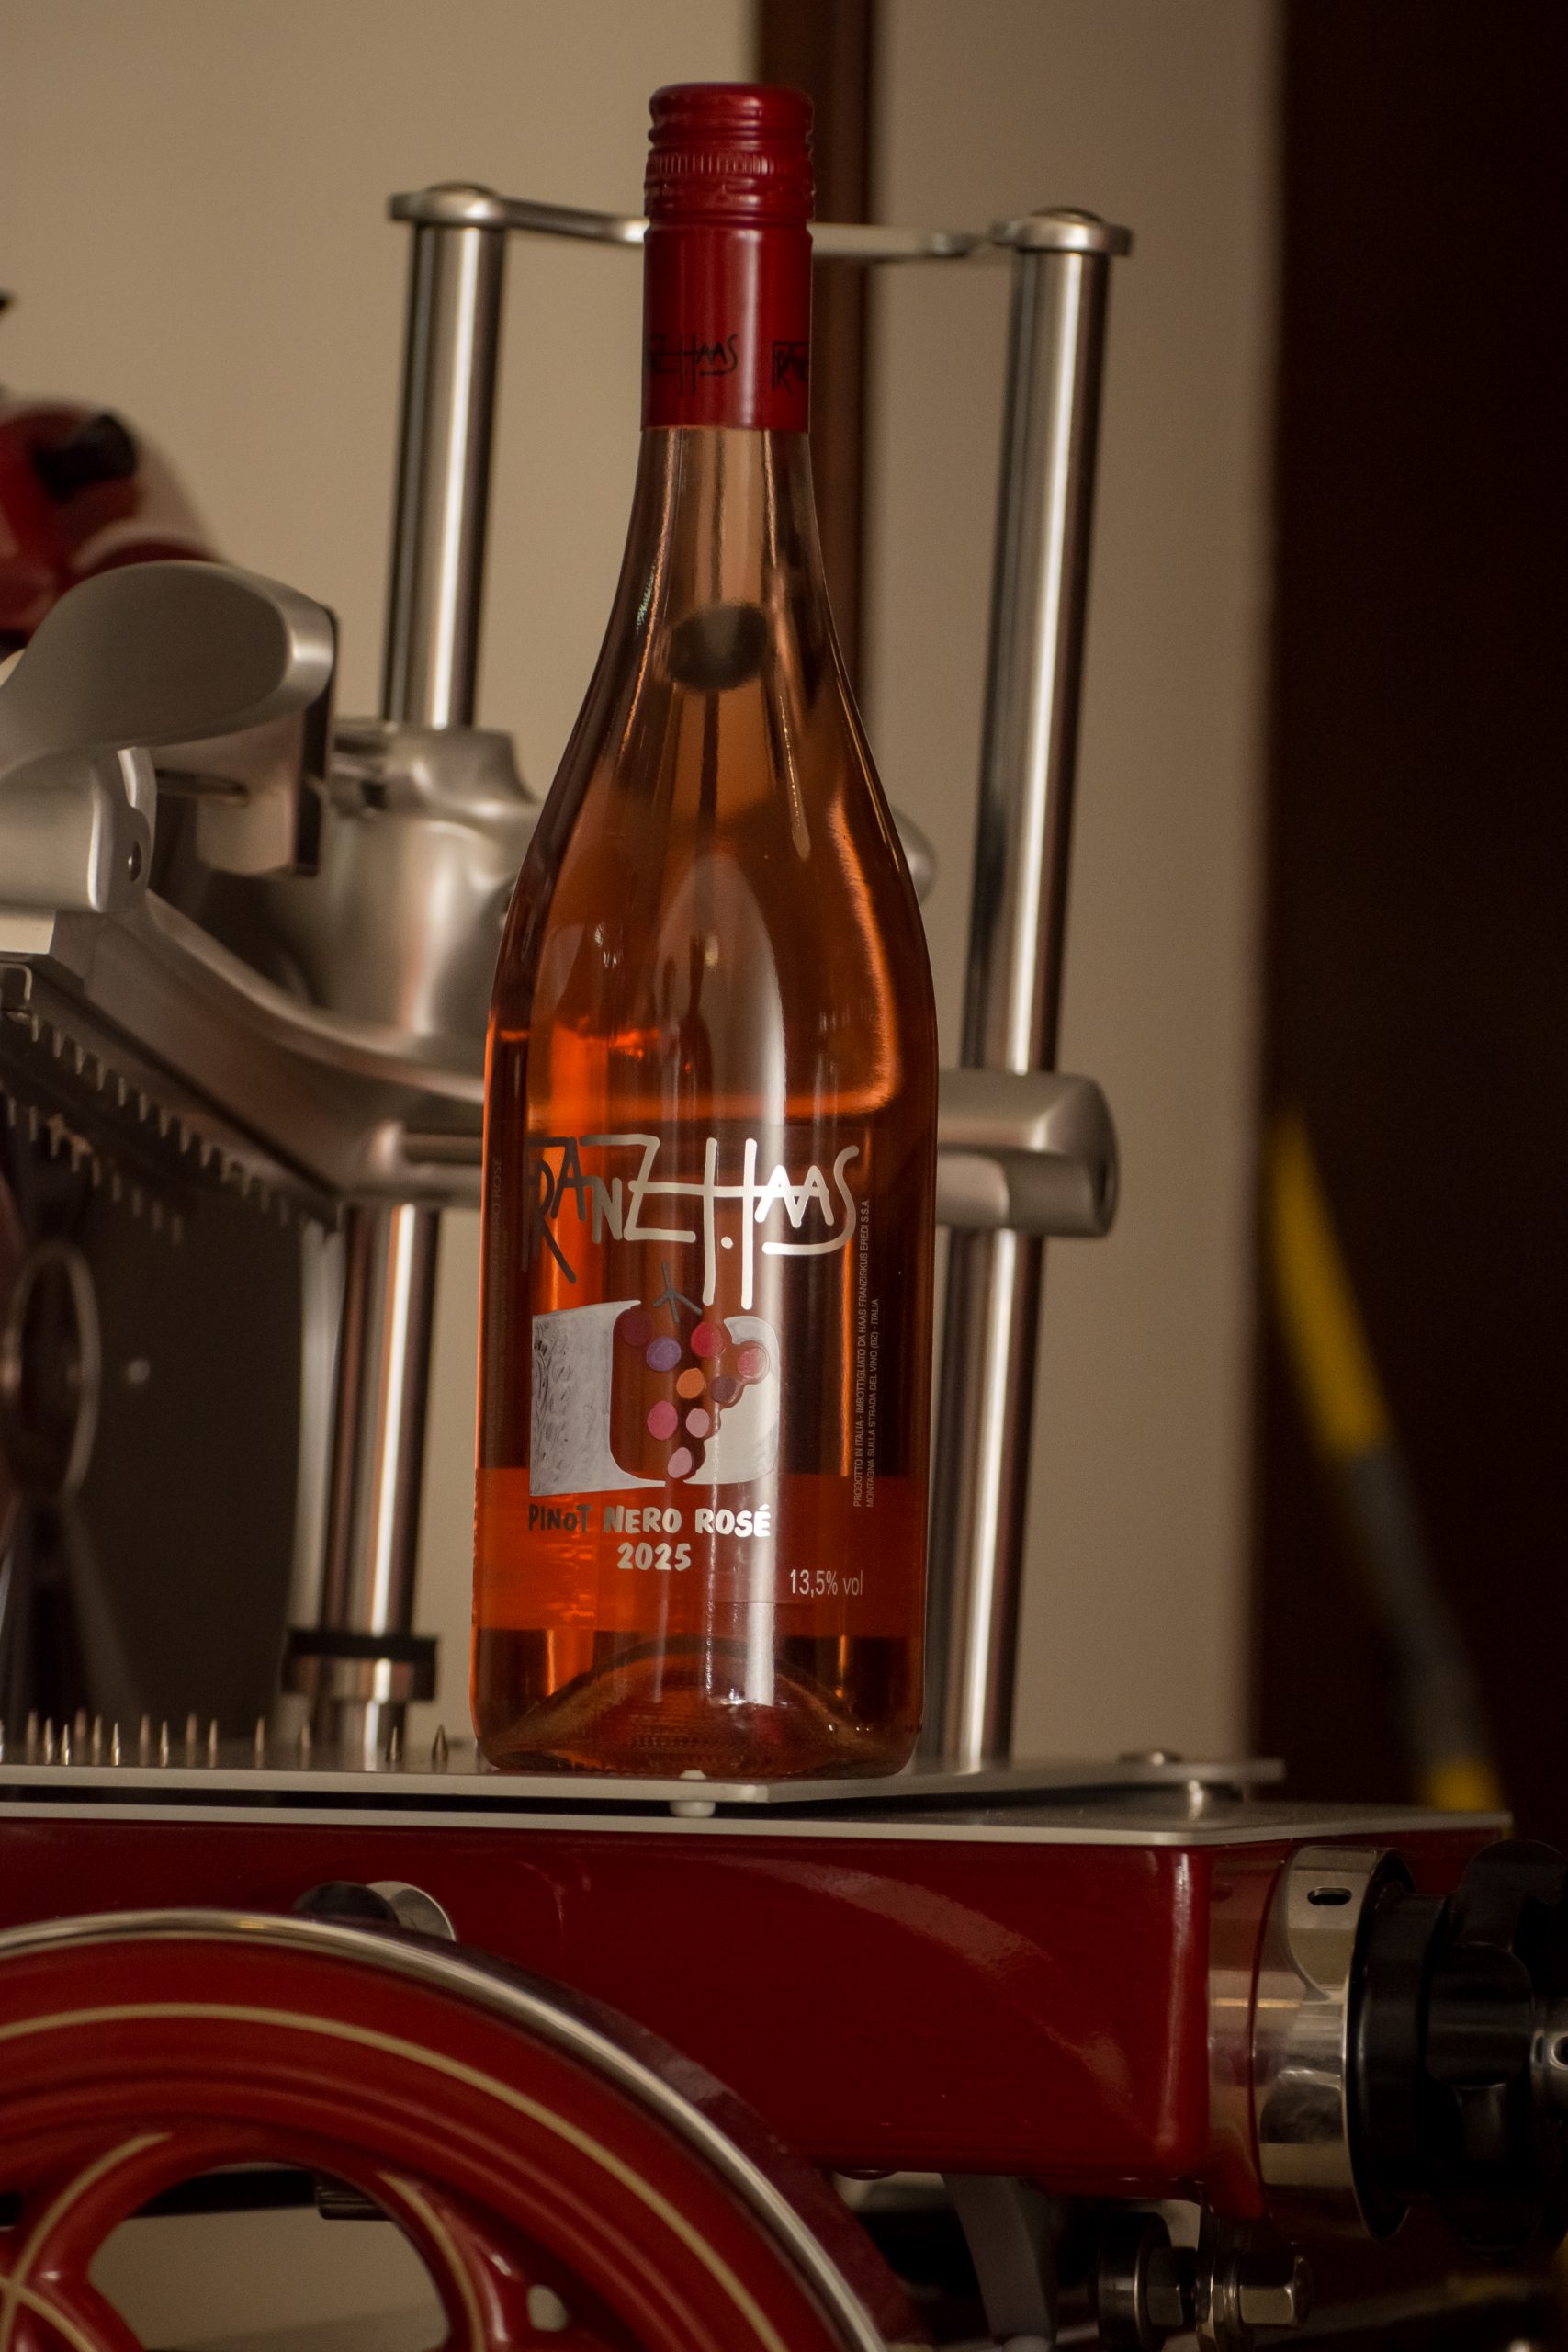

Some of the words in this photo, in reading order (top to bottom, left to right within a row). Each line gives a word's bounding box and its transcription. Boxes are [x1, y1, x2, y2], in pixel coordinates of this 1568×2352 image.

[859, 1224, 870, 1251] EREDI
[858, 1252, 869, 1307] FRANZISKUS
[858, 1308, 868, 1333] HAAS
[871, 1298, 880, 1325] ITALIA
[857, 1335, 867, 1347] DA
[870, 1330, 881, 1349] (BZ)
[870, 1350, 879, 1372] VINO
[855, 1348, 867, 1414] IMBOTTIGLIATO
[869, 1374, 878, 1391] DEL
[868, 1392, 878, 1428] STRADA
[854, 1419, 864, 1446] ITALIA
[866, 1429, 876, 1457] SULLA
[853, 1447, 864, 1457] IN
[852, 1458, 863, 1508] PRODOTTO
[865, 1457, 875, 1508] MONTAGNA
[604, 1505, 682, 1534] NERO
[694, 1503, 771, 1537] ROSÉ
[616, 1542, 691, 1571] 2025
[790, 1568, 838, 1597] 13,5%
[842, 1569, 863, 1596] vol
